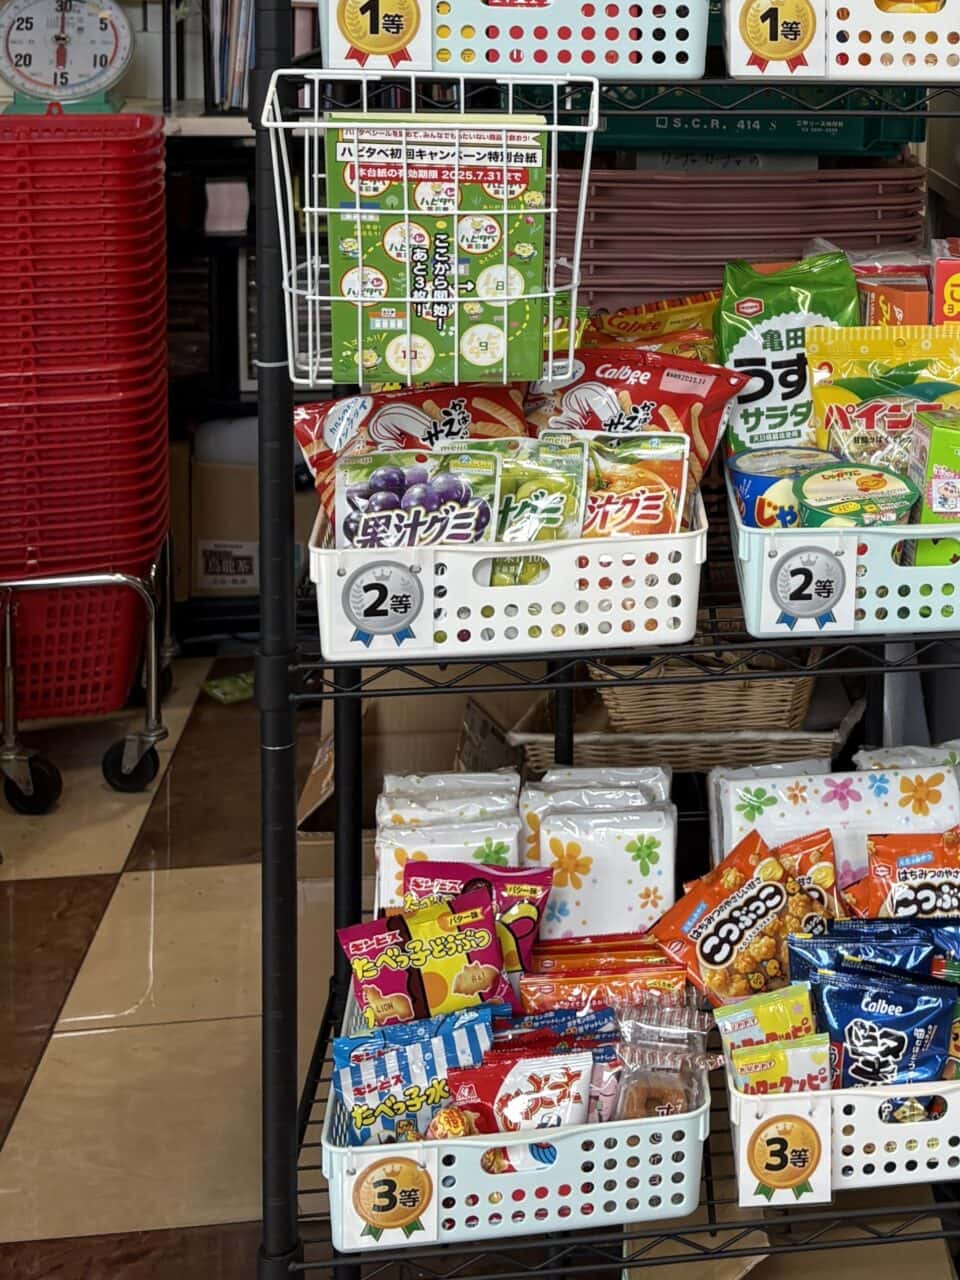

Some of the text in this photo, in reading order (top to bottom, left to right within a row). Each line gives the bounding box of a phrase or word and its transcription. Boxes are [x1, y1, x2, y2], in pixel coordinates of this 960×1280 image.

[16, 16, 34, 31] 25
[99, 18, 108, 31] 5
[760, 7, 802, 43] 1等
[14, 53, 33, 67] 20
[92, 54, 108, 67] 10
[53, 72, 69, 86] 15
[736, 119, 761, 131] 414
[595, 363, 652, 385] Calbee
[788, 567, 834, 602] 2等
[362, 583, 412, 618] 2等
[508, 885, 540, 896] バター味
[449, 912, 480, 924] バター味
[701, 885, 782, 963] こつぶっこ
[352, 928, 492, 981] たべっ子どうぶつ
[860, 998, 903, 1017] Calbee
[764, 1136, 809, 1171] 3等
[371, 1178, 420, 1213] 3等
